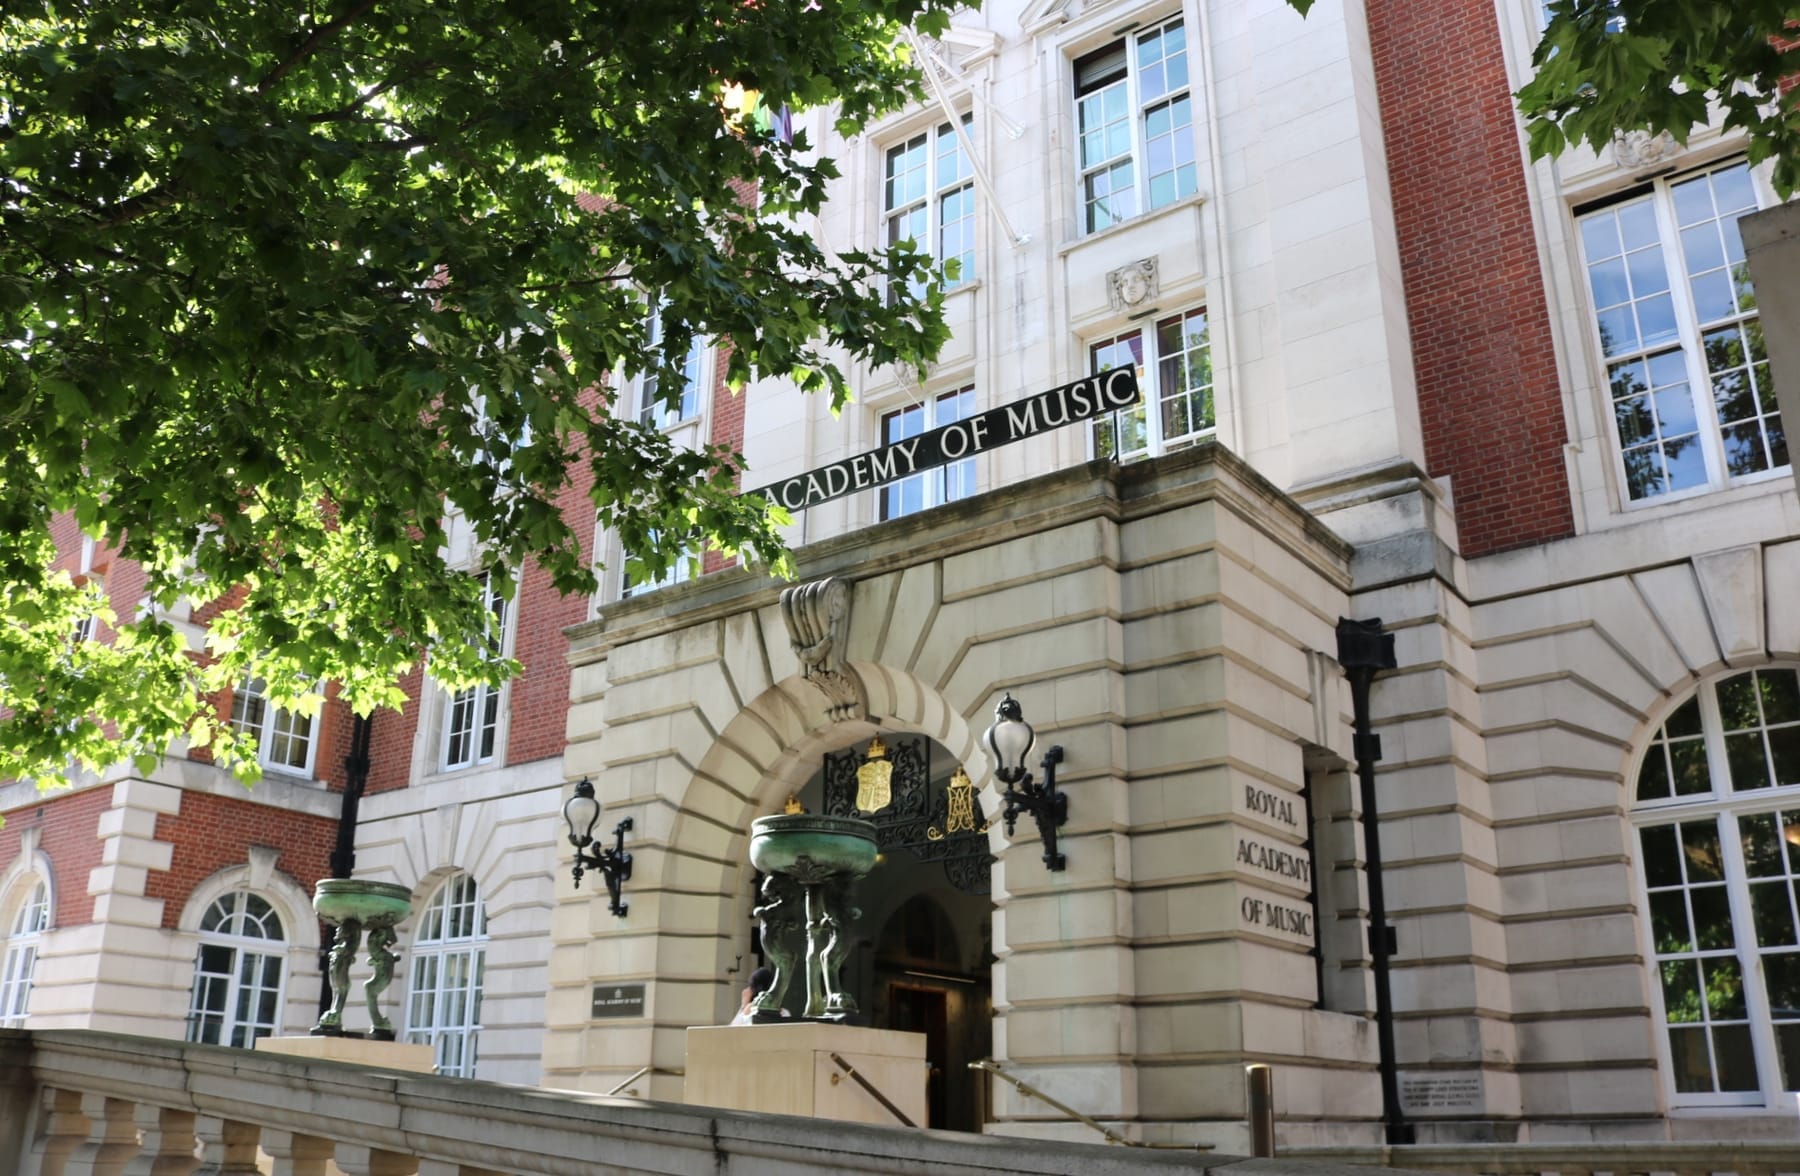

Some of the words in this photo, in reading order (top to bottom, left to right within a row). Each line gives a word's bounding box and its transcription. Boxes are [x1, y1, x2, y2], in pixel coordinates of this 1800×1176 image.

[763, 437, 921, 519] ACADEMY
[940, 415, 989, 458] OF
[1005, 369, 1136, 440] MUSIC
[1245, 784, 1298, 827] ROYAL
[1236, 838, 1311, 883] ACADEMY
[1241, 896, 1264, 925] OF
[1266, 903, 1313, 938] MUSIC
